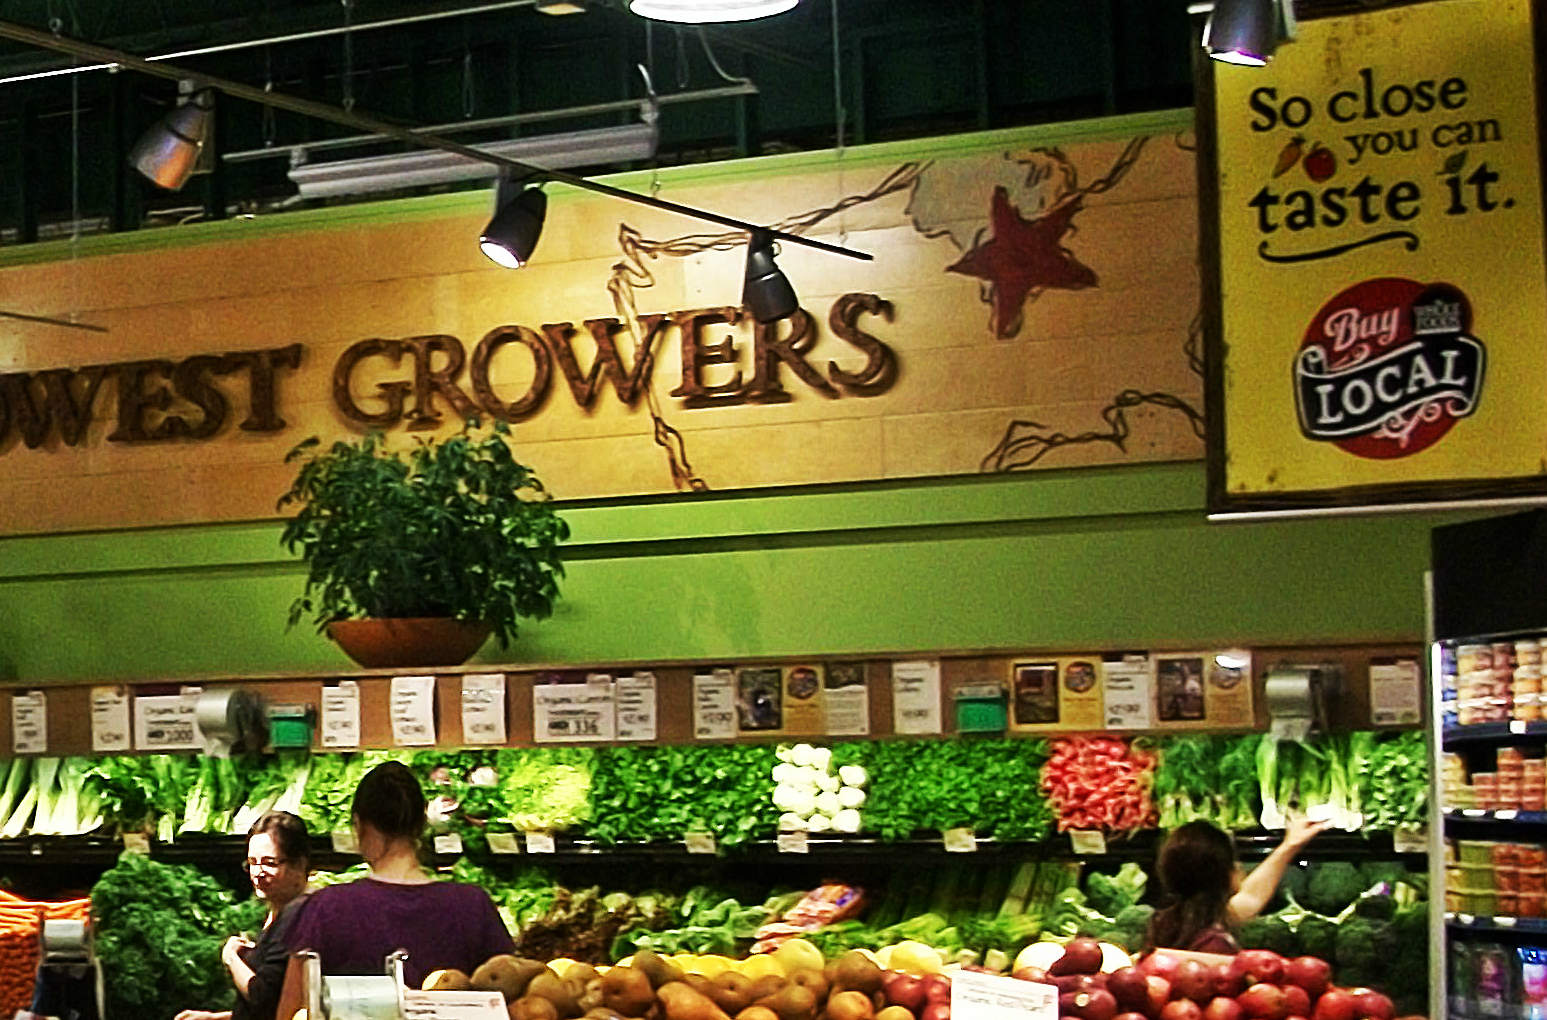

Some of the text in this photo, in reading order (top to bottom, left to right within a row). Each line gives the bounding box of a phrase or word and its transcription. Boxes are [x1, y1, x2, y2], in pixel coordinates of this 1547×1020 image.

[1249, 68, 1468, 132] So close
[1344, 118, 1502, 165] you can
[1248, 158, 1516, 234] taste it.
[333, 292, 900, 432] GROWERS
[1324, 304, 1400, 352] Buy
[1315, 349, 1468, 425] LOCAL
